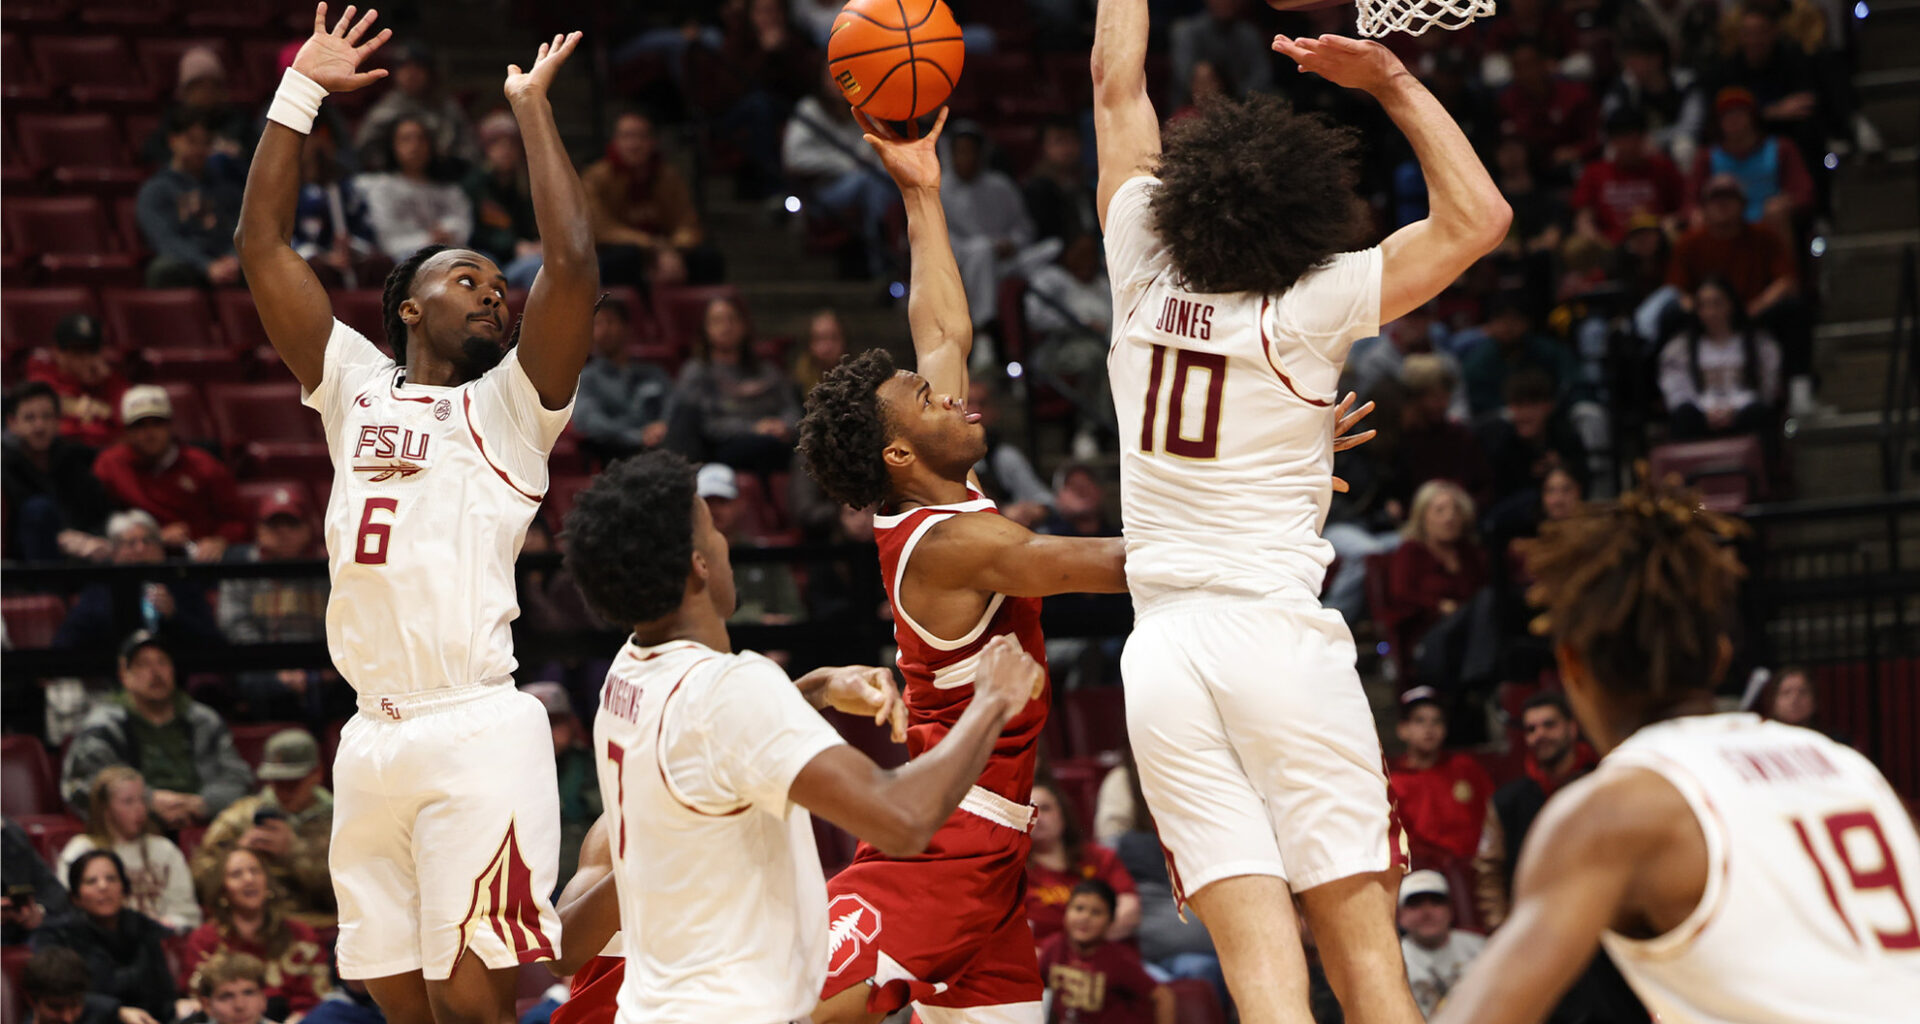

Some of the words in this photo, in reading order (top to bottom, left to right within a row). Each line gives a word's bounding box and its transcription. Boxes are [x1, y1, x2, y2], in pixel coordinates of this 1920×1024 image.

[1156, 296, 1215, 341] JONES
[1140, 343, 1230, 462] 10
[353, 425, 430, 461] FSU
[354, 497, 399, 566] 6
[381, 698, 402, 720] FSU
[604, 673, 644, 724] WIGGINS
[607, 738, 626, 861] 7
[1786, 806, 1920, 953] 19
